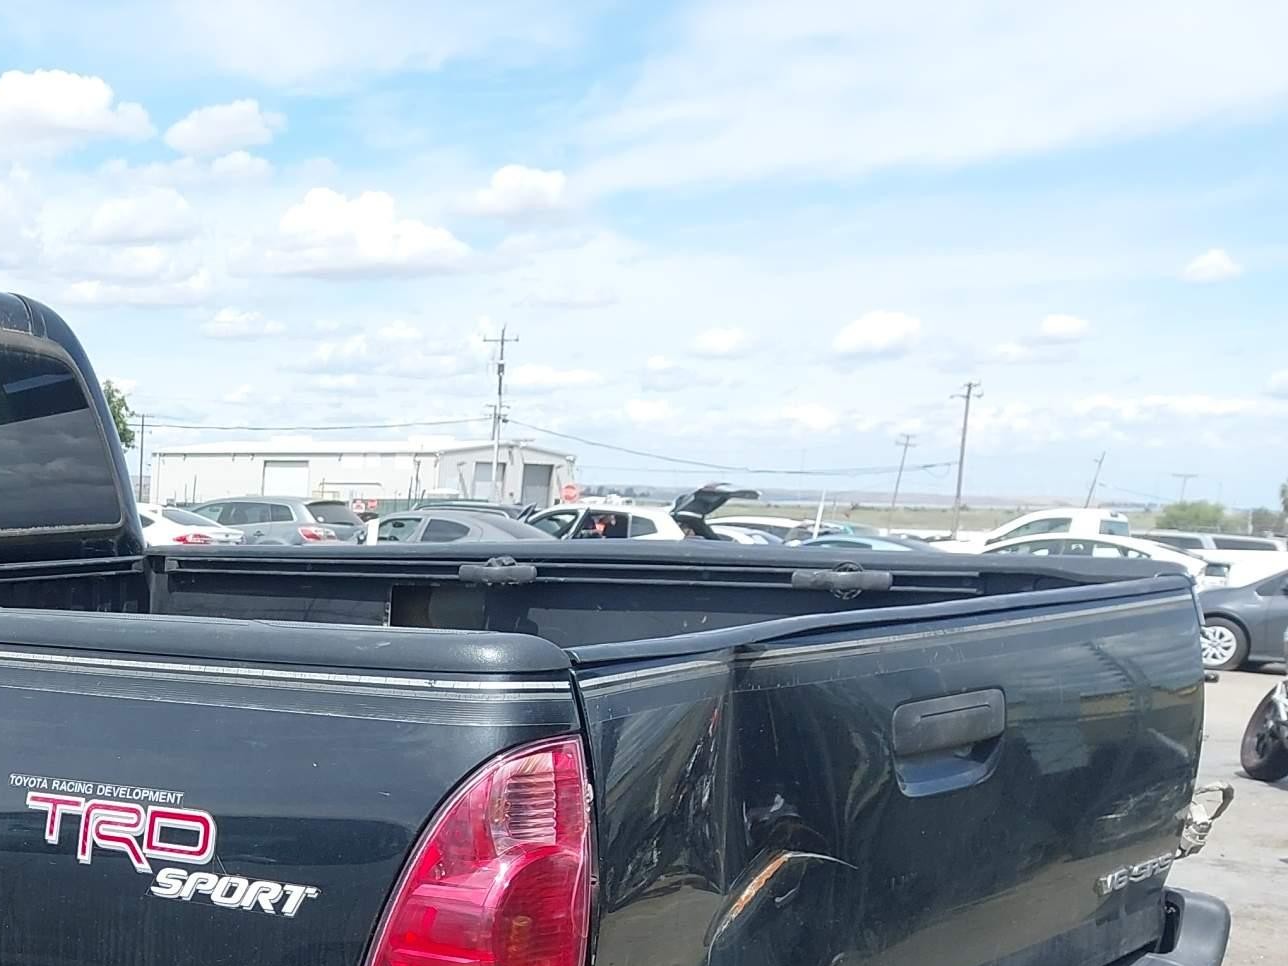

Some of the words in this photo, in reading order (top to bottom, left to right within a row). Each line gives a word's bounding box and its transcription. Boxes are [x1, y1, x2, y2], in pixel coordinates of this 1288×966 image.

[9, 774, 48, 790] TOYOTA
[52, 779, 93, 795] RACING
[96, 784, 184, 805] DEVELOPMENT
[26, 791, 217, 874] TRD
[150, 867, 321, 918] SPORT
